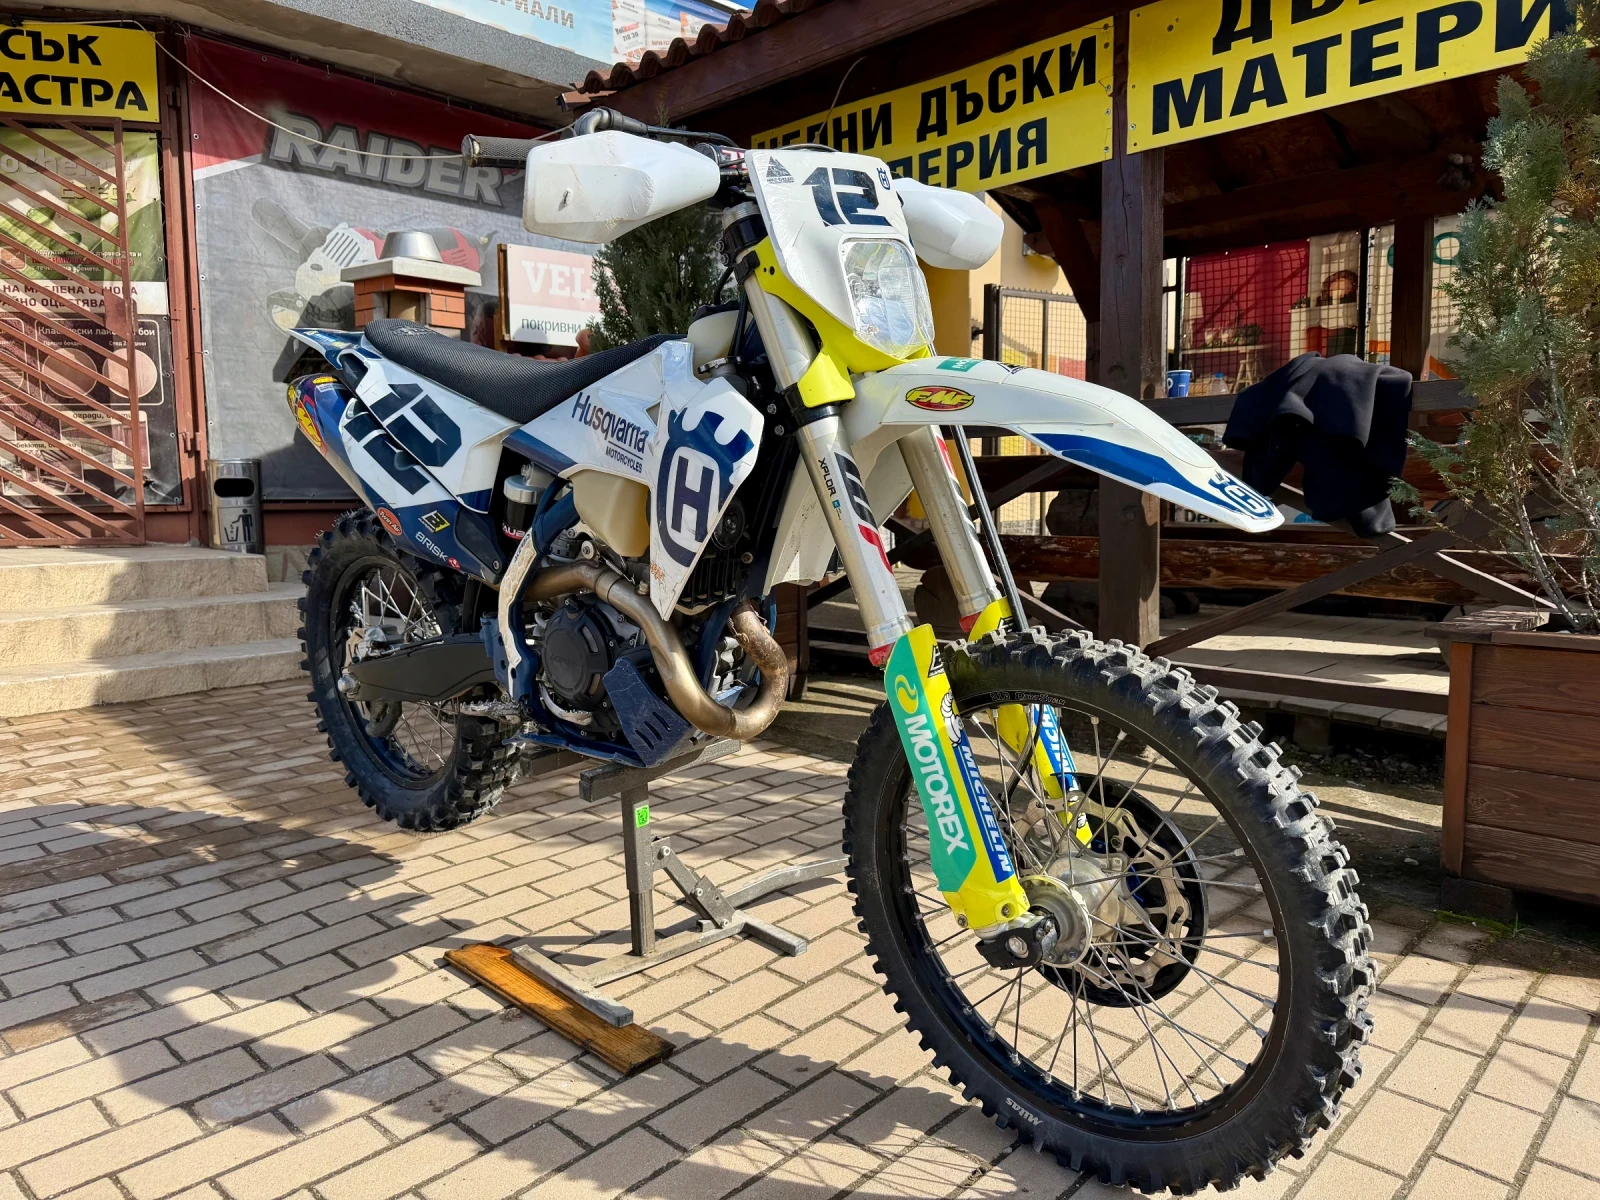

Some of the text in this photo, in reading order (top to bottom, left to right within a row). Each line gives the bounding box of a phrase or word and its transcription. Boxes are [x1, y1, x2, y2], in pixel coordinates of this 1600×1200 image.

[0, 71, 148, 111] АСТРА
[917, 35, 1096, 142] ДЪСКИ
[268, 113, 505, 206] RAIDER
[802, 166, 892, 227] 12
[521, 260, 597, 301] VEL
[138, 328, 156, 336] бои
[521, 318, 581, 334] покривни
[906, 390, 975, 406] FMF
[571, 391, 649, 454] Husqvarna
[605, 445, 643, 474] MOTORCYCLES
[818, 457, 837, 497] XPLOR
[415, 531, 448, 562] BRISK
[905, 715, 970, 854] MOTOREX
[962, 744, 1011, 873] MICHELIN
